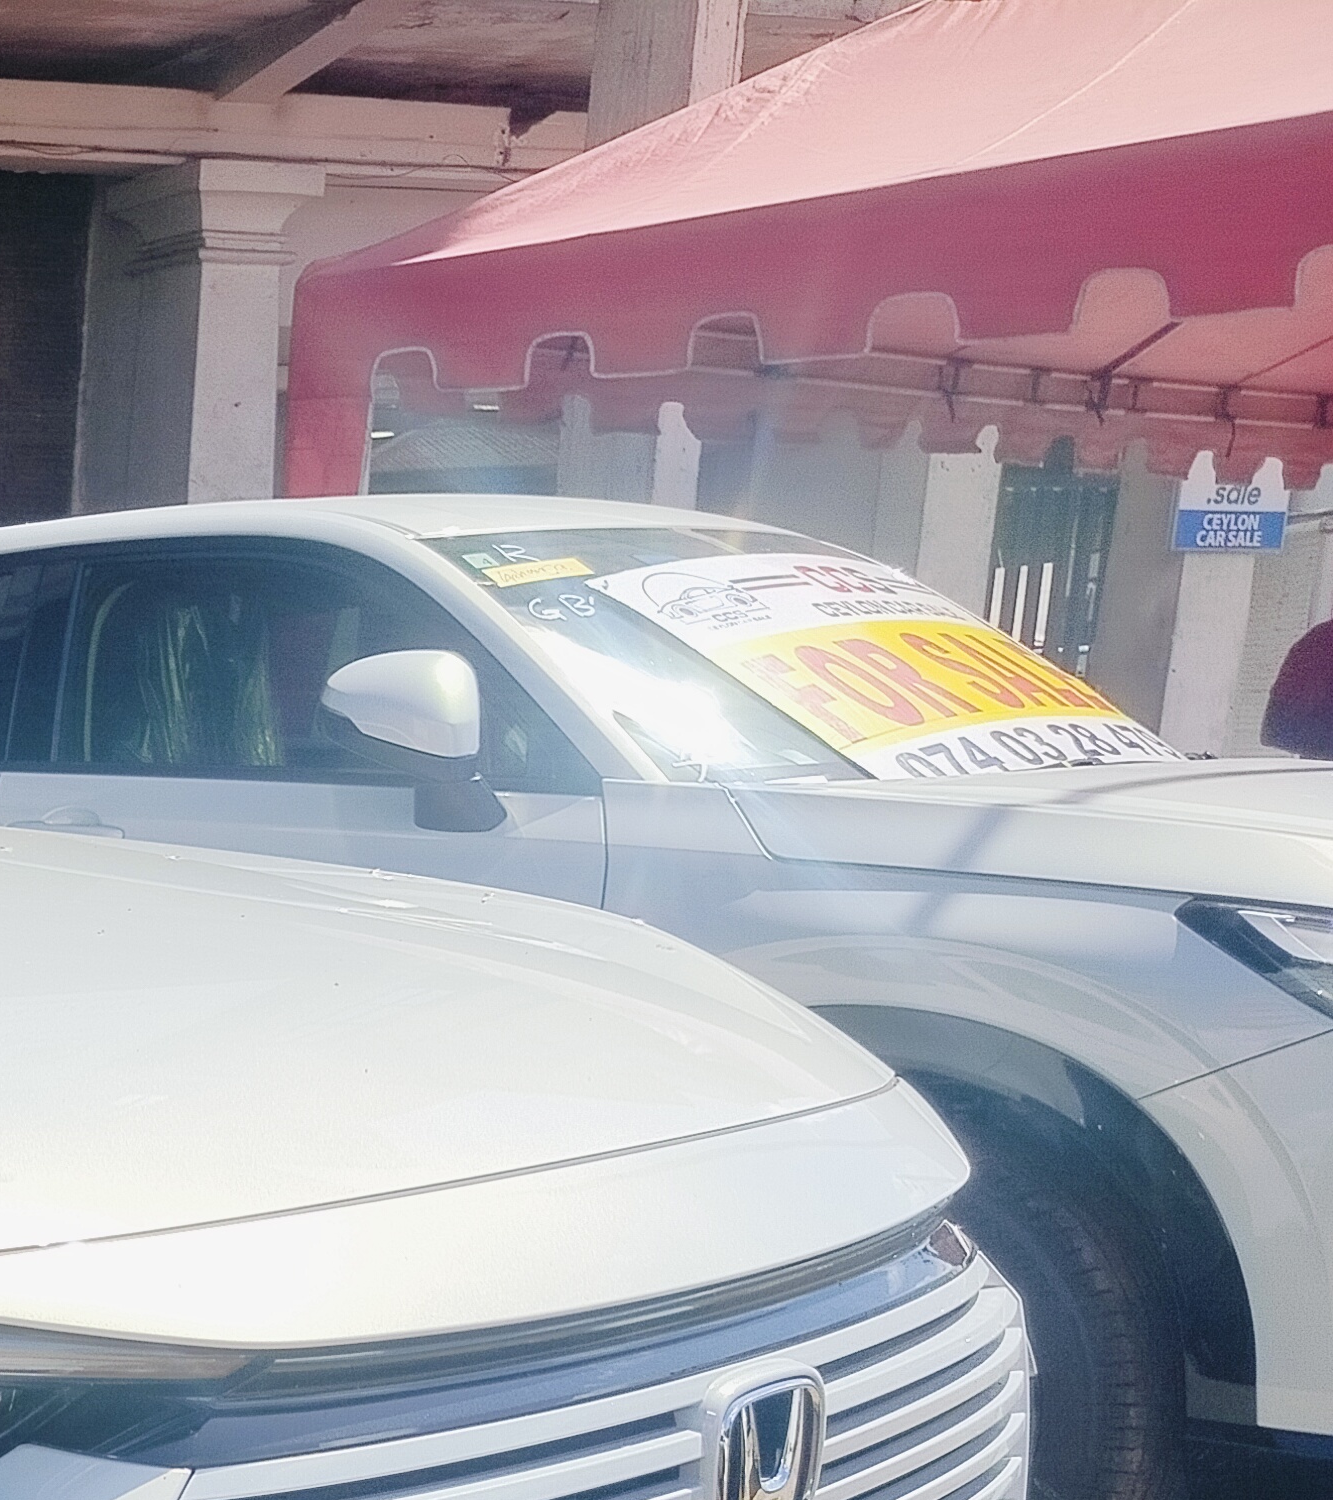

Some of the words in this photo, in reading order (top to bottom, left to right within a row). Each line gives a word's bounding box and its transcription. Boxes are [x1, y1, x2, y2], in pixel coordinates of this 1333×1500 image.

[1202, 513, 1260, 531] CEYLON
[1196, 531, 1225, 547] CAR
[1226, 531, 1262, 547] SALE
[793, 564, 899, 595] CCS
[742, 637, 983, 746] FOR
[990, 726, 1069, 766] 03
[1057, 722, 1122, 758] 28
